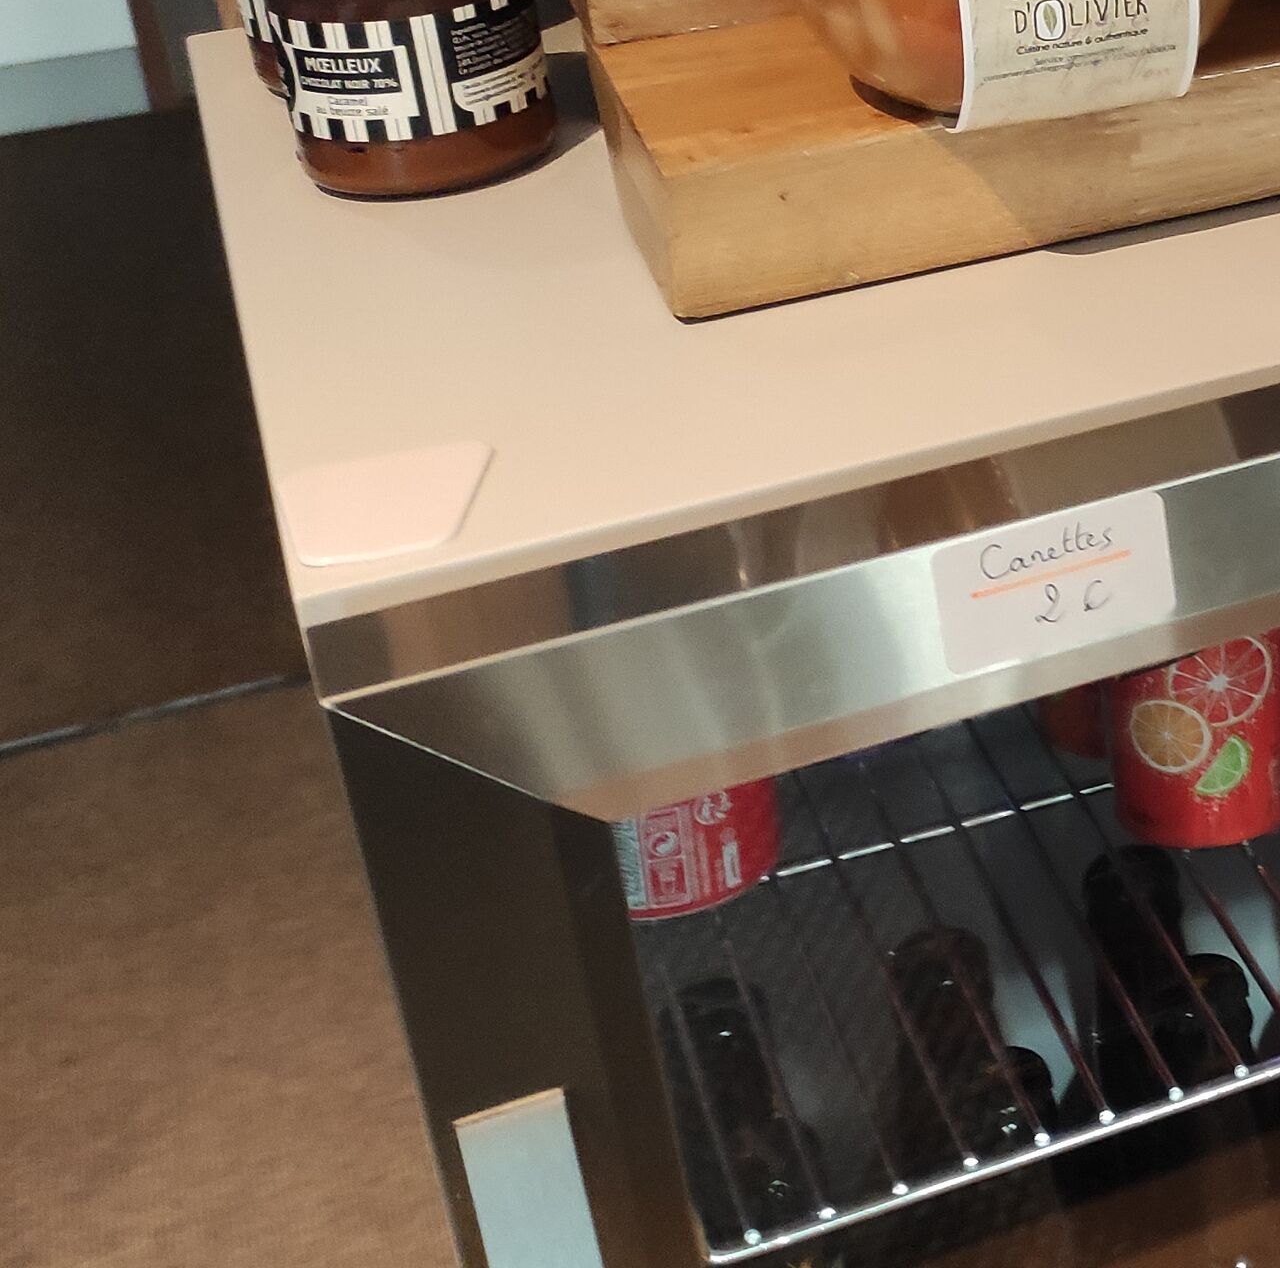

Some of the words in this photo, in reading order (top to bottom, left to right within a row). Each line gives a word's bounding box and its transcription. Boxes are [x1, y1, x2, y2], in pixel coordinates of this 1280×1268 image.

[327, 96, 368, 106] Caramel
[980, 521, 1112, 580] Canettes
[1034, 583, 1064, 623] 2
